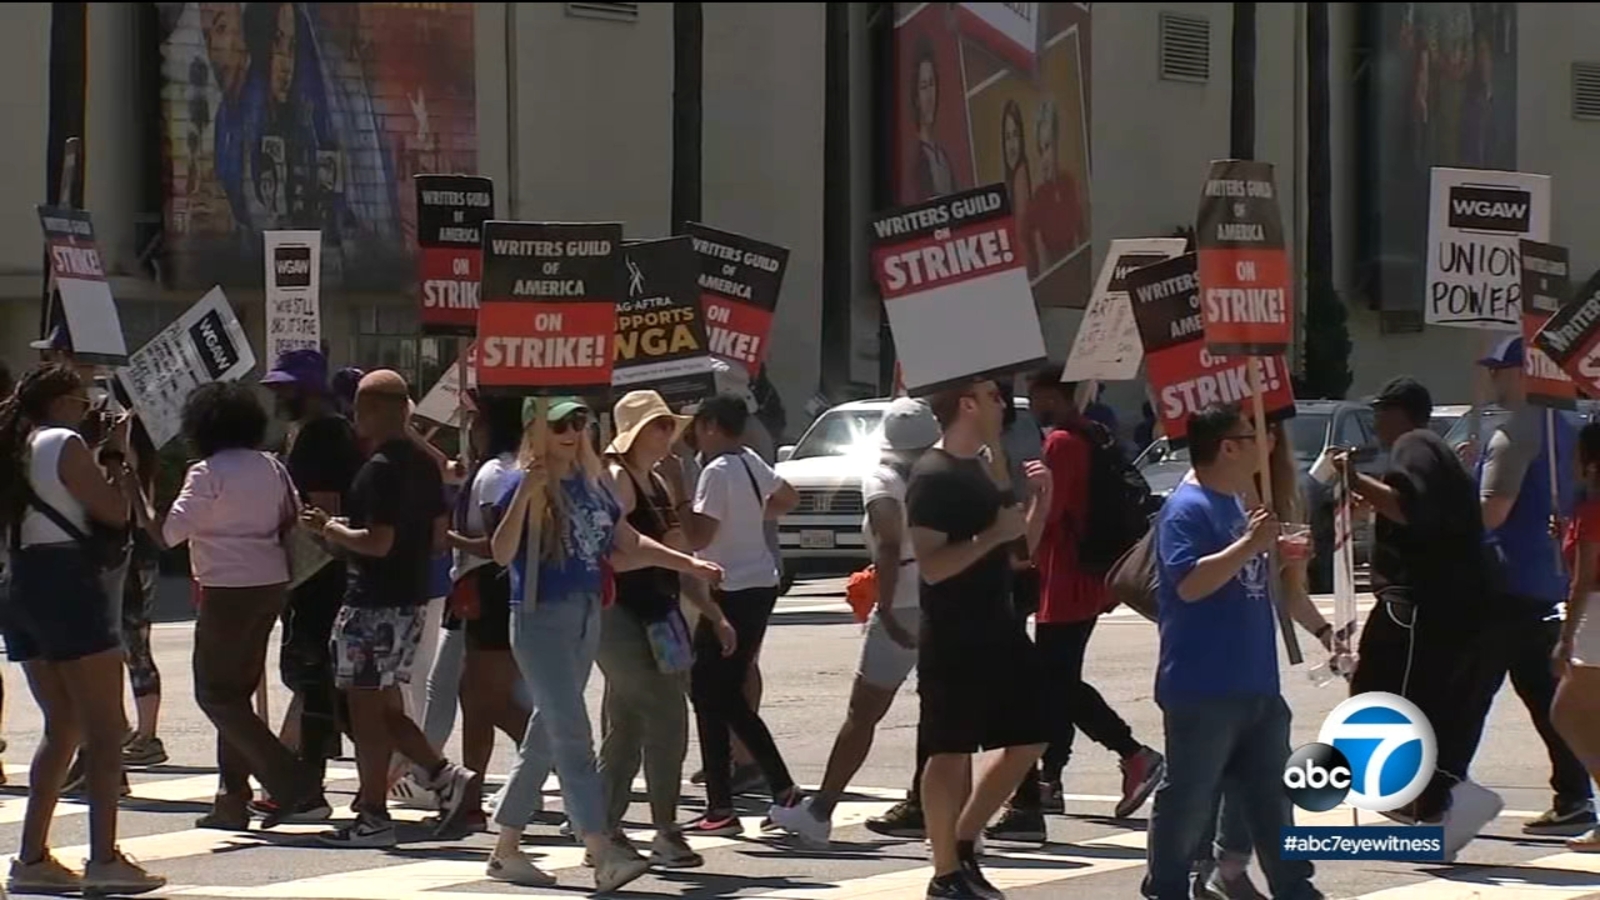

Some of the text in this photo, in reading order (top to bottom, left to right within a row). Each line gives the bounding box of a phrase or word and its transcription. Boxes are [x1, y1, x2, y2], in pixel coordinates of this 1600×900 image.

[421, 190, 491, 207] WRITERS GUILD
[1452, 198, 1528, 219] WGAW
[453, 210, 465, 223] OF
[873, 192, 1002, 239] WRITERS GUILD
[438, 227, 480, 243] AMERICA
[933, 227, 951, 240] ON
[1217, 223, 1265, 241] AMERICA
[492, 239, 612, 257] WRITERS GUILD
[276, 259, 310, 275] WGAW
[452, 258, 470, 275] ON
[542, 261, 560, 275] OF
[721, 263, 737, 276] OF
[743, 252, 780, 273] GUILD
[883, 228, 1014, 291] STRIKE!
[1439, 242, 1521, 277] UNION
[1235, 260, 1256, 281] ON
[423, 279, 481, 309] STRIK
[513, 279, 586, 296] AMERICA
[697, 273, 753, 300] AMERICA
[614, 296, 673, 312] AG-AFTRA
[1189, 294, 1200, 309] O
[1205, 287, 1285, 323] STRIKE!
[1432, 282, 1521, 317] POWER
[534, 313, 563, 332] ON
[614, 306, 695, 331] PPORTS
[707, 304, 731, 324] ON
[199, 317, 231, 371] WGAW
[483, 335, 606, 369] STRIKE!
[706, 325, 760, 363] IKE!
